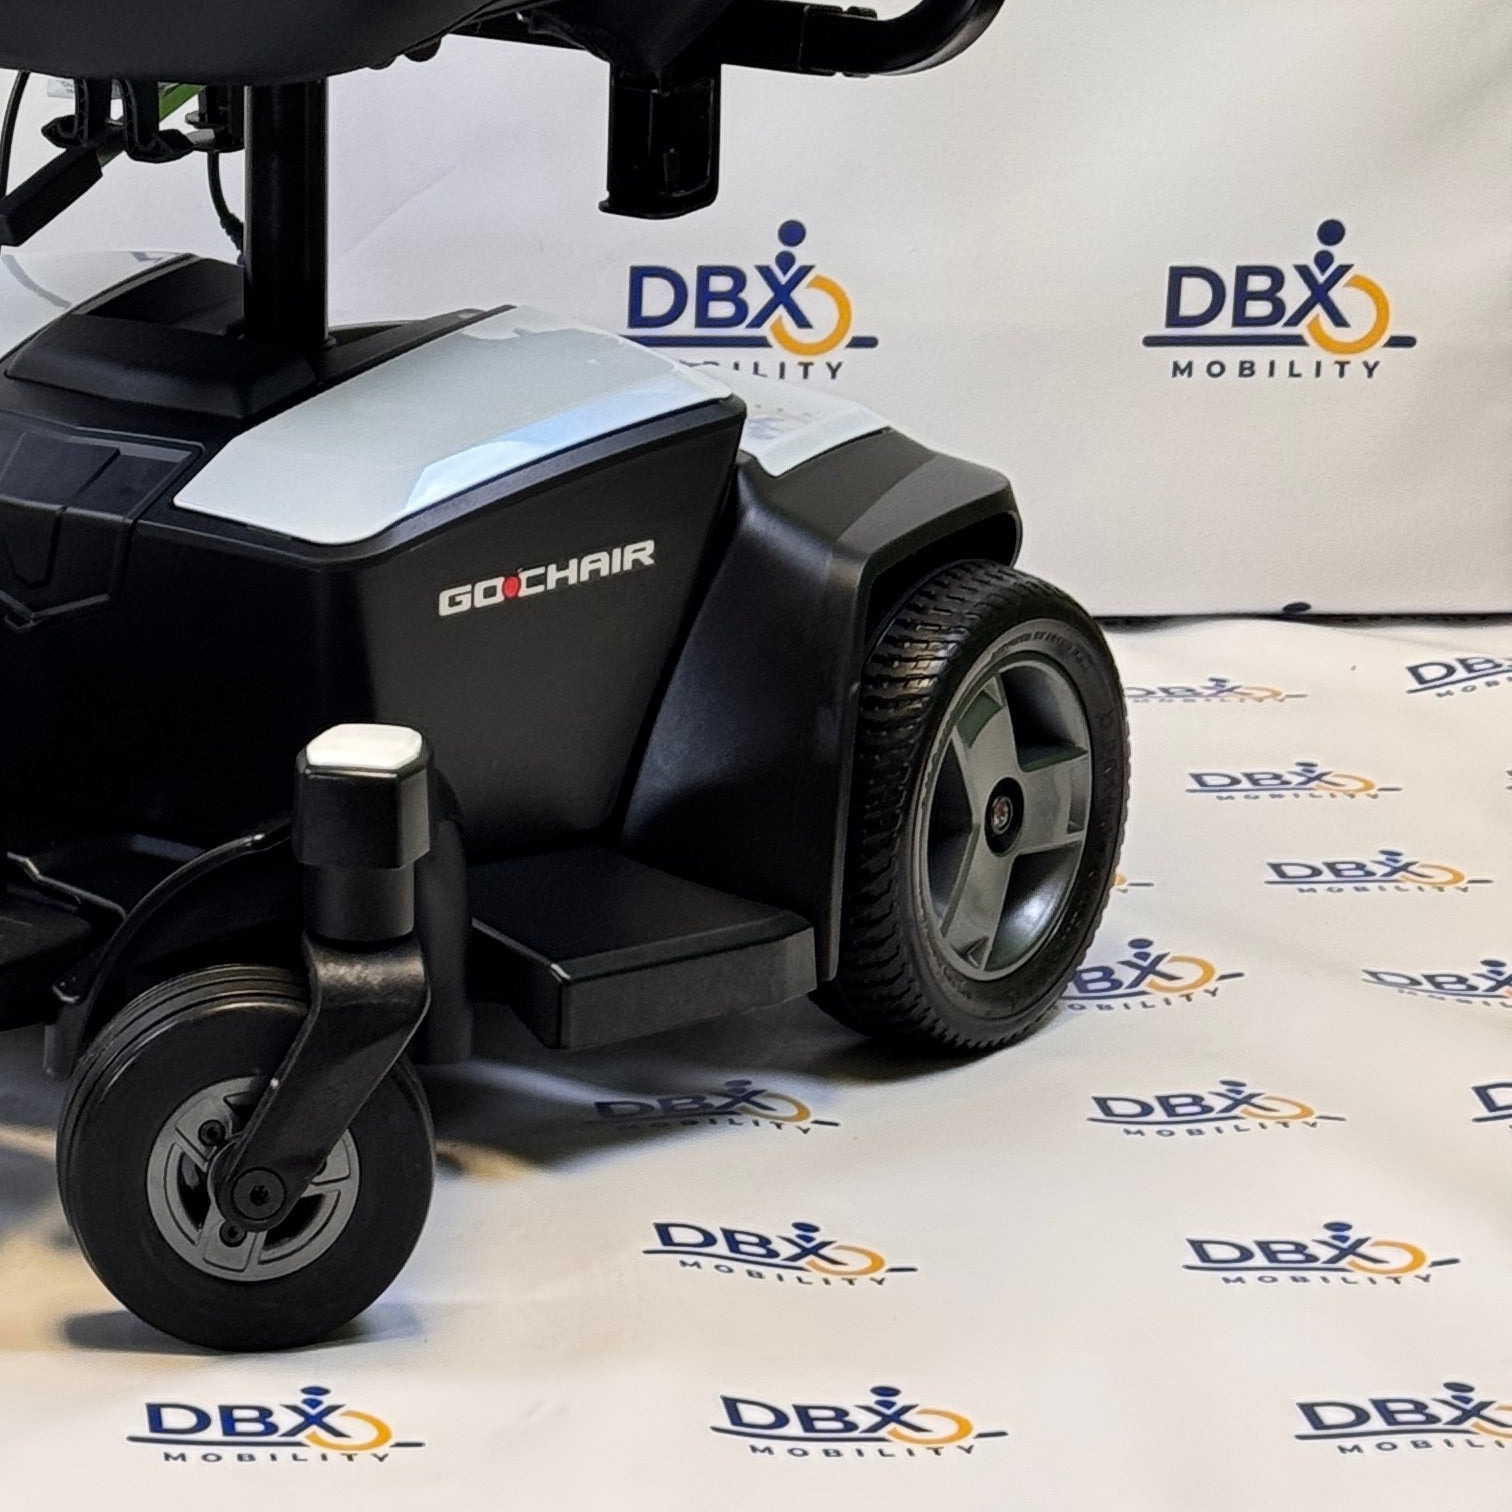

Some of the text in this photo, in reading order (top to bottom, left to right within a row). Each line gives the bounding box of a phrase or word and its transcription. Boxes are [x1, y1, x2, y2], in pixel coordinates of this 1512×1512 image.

[628, 265, 815, 329] DBX
[1165, 264, 1354, 328] DBX
[734, 362, 842, 379] ILITY
[1172, 360, 1379, 378] MOBILITY
[1406, 656, 1512, 685] DB
[1189, 772, 1343, 788] DBX
[1267, 861, 1434, 879] DBX
[1072, 952, 1183, 994] BX
[1067, 987, 1218, 1010] OBILITY
[1092, 1092, 1277, 1119] DBX
[1124, 1121, 1317, 1137] MOBILITY
[654, 1222, 847, 1268] DBX
[1186, 1235, 1373, 1266] DBX
[680, 1260, 885, 1285] MOBILITY
[1222, 1274, 1431, 1284] MOBILITY
[146, 1401, 347, 1438] DBX
[720, 1395, 932, 1433] DBX
[1296, 1399, 1512, 1432] DBX
[164, 1452, 388, 1462] MOBILITY
[750, 1445, 973, 1457] MOBILITY
[1337, 1439, 1504, 1454] MOBILI
